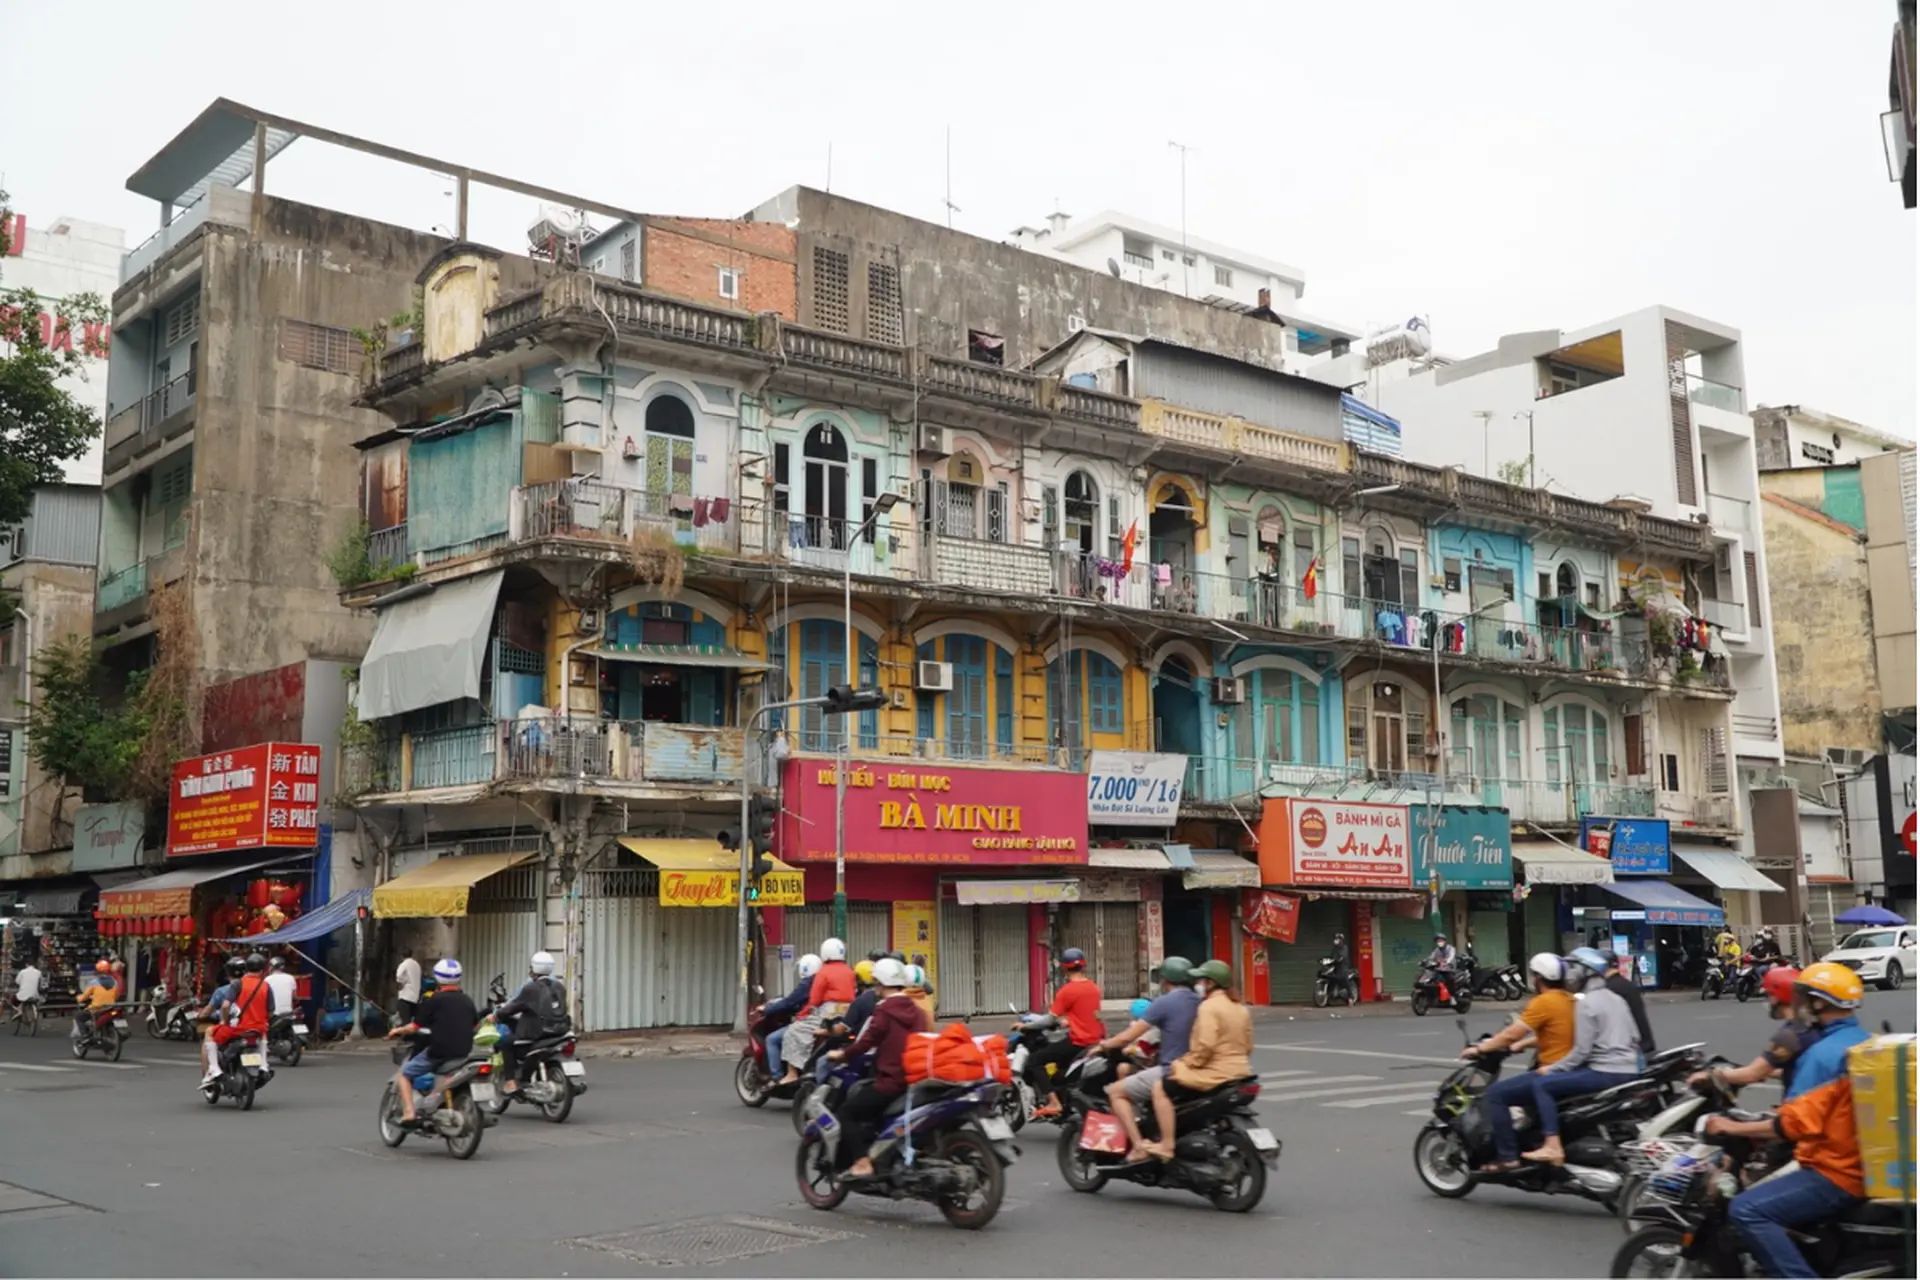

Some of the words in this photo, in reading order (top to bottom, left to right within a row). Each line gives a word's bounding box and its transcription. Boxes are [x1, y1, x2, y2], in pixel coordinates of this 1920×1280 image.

[295, 751, 318, 775] TÂN
[290, 805, 318, 828] PHÁT
[879, 793, 926, 828] BÀ
[934, 803, 1022, 832] MINH
[1336, 809, 1368, 825] BÁNH
[1370, 812, 1384, 827] MÌ
[1385, 812, 1402, 828] GÀ
[1472, 834, 1503, 865] Tiến
